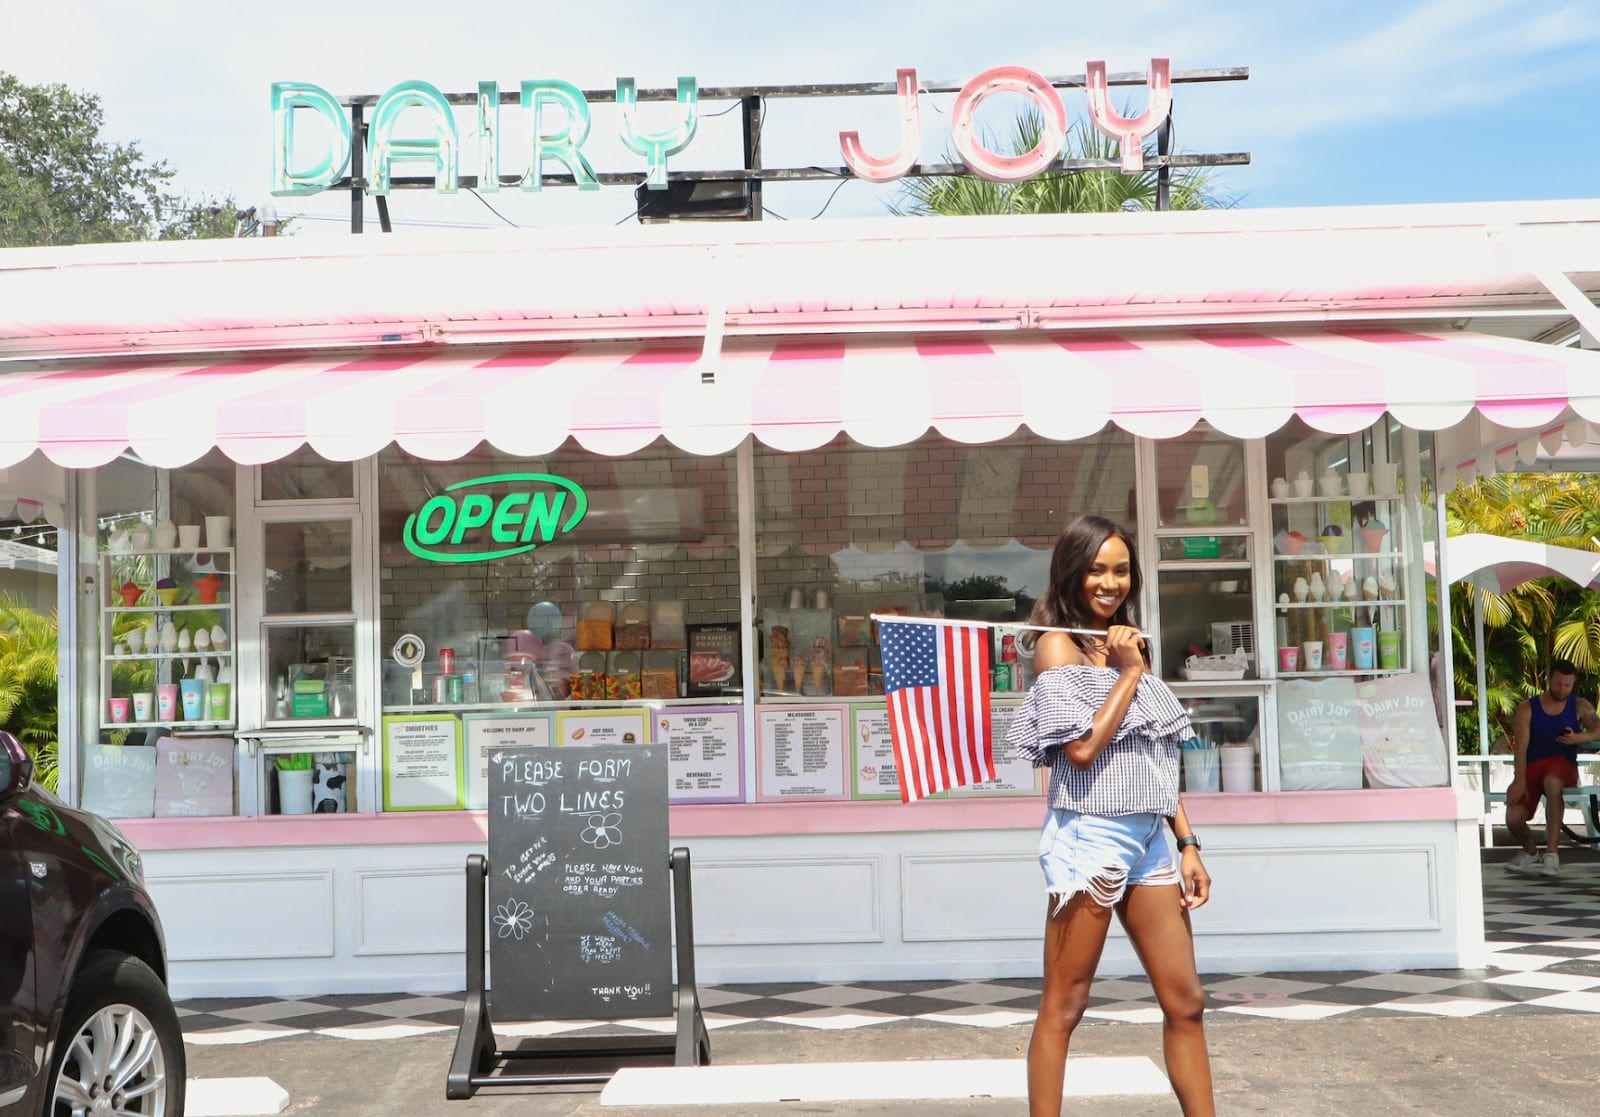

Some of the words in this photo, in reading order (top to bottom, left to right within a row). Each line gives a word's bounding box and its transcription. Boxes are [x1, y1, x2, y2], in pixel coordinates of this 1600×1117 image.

[271, 77, 698, 195] DAIRY
[839, 58, 1171, 184] JOY
[415, 491, 568, 545] OPEN
[1287, 704, 1326, 724] DAIRY
[1327, 702, 1352, 717] JOY
[1363, 700, 1401, 718] DAIRY
[1403, 696, 1427, 708] JOY
[93, 755, 129, 769] DAIRY
[130, 756, 153, 773] JOY
[206, 752, 227, 769] JOY
[503, 761, 563, 785] PLEASE
[577, 759, 631, 781] FORM
[501, 792, 546, 817] TWO
[560, 790, 625, 812] LINES
[503, 864, 516, 879] TO
[565, 863, 597, 874] PLEASE
[602, 863, 622, 873] HAVE
[623, 864, 644, 874] YOU
[565, 876, 582, 885] AND
[585, 875, 608, 886] YOUR
[563, 885, 589, 894] ORDER
[593, 886, 618, 897] READY
[592, 986, 622, 996] THANK
